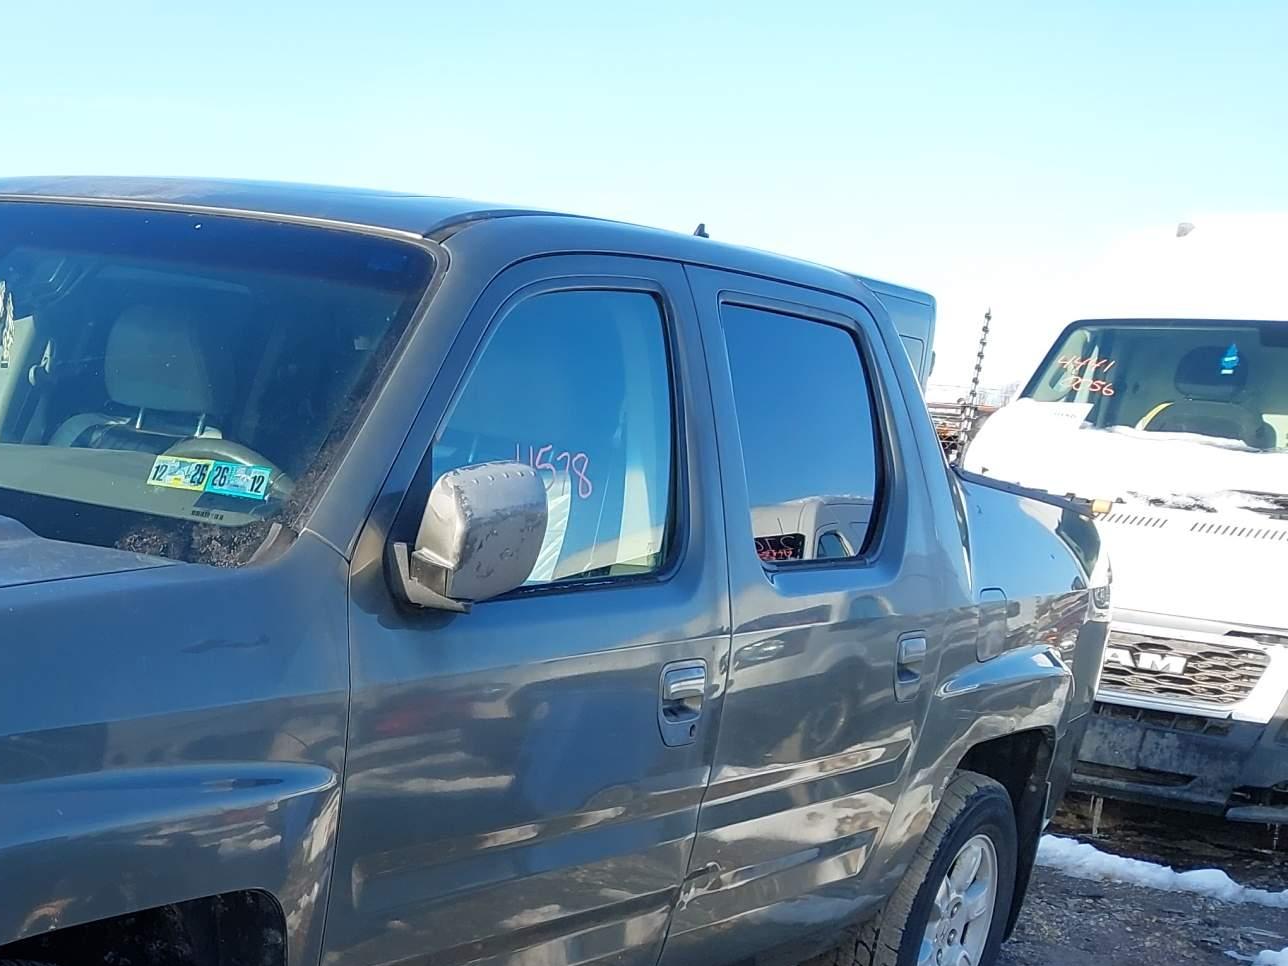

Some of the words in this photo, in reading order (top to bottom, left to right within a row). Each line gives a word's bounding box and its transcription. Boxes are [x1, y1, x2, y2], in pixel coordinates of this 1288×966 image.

[152, 464, 168, 481] 12
[212, 465, 230, 487] 26
[249, 474, 265, 493] 12
